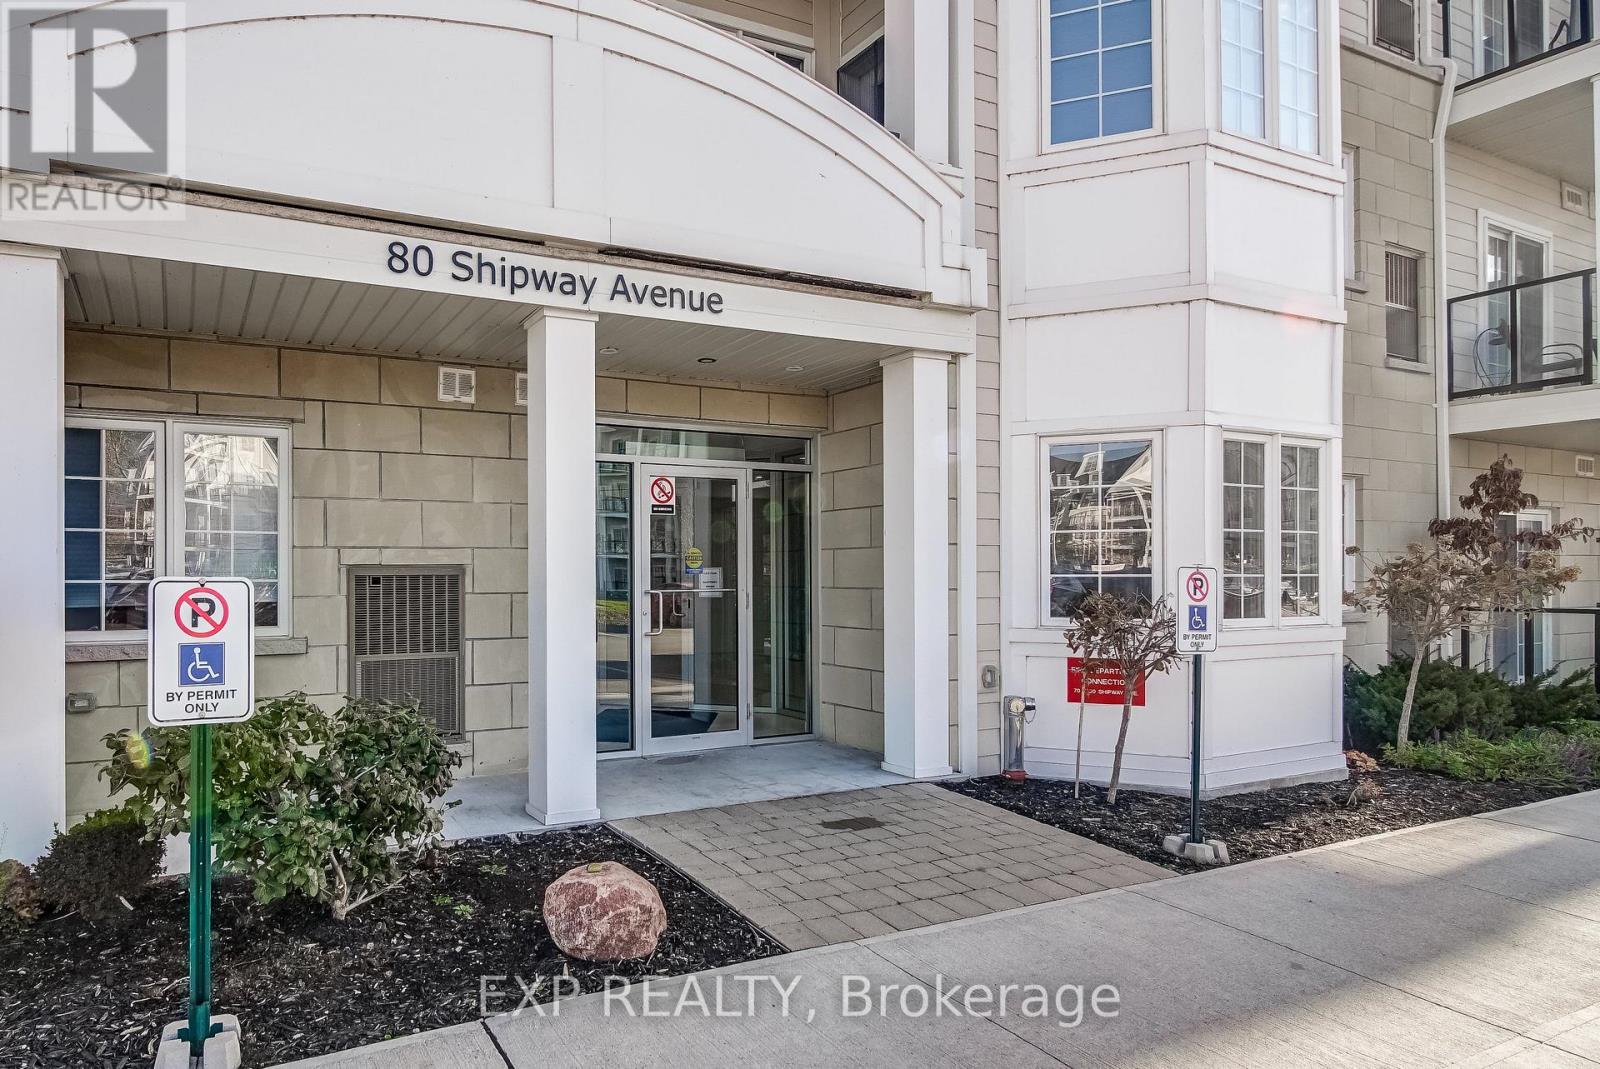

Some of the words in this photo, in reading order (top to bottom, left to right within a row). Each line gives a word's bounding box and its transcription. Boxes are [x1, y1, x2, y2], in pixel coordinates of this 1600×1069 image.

[387, 241, 434, 277] 80
[450, 250, 597, 304] Shipway
[609, 274, 724, 314] Avenue
[166, 692, 183, 702] BY
[187, 689, 237, 701] PERMIT
[184, 702, 219, 714] ONLY
